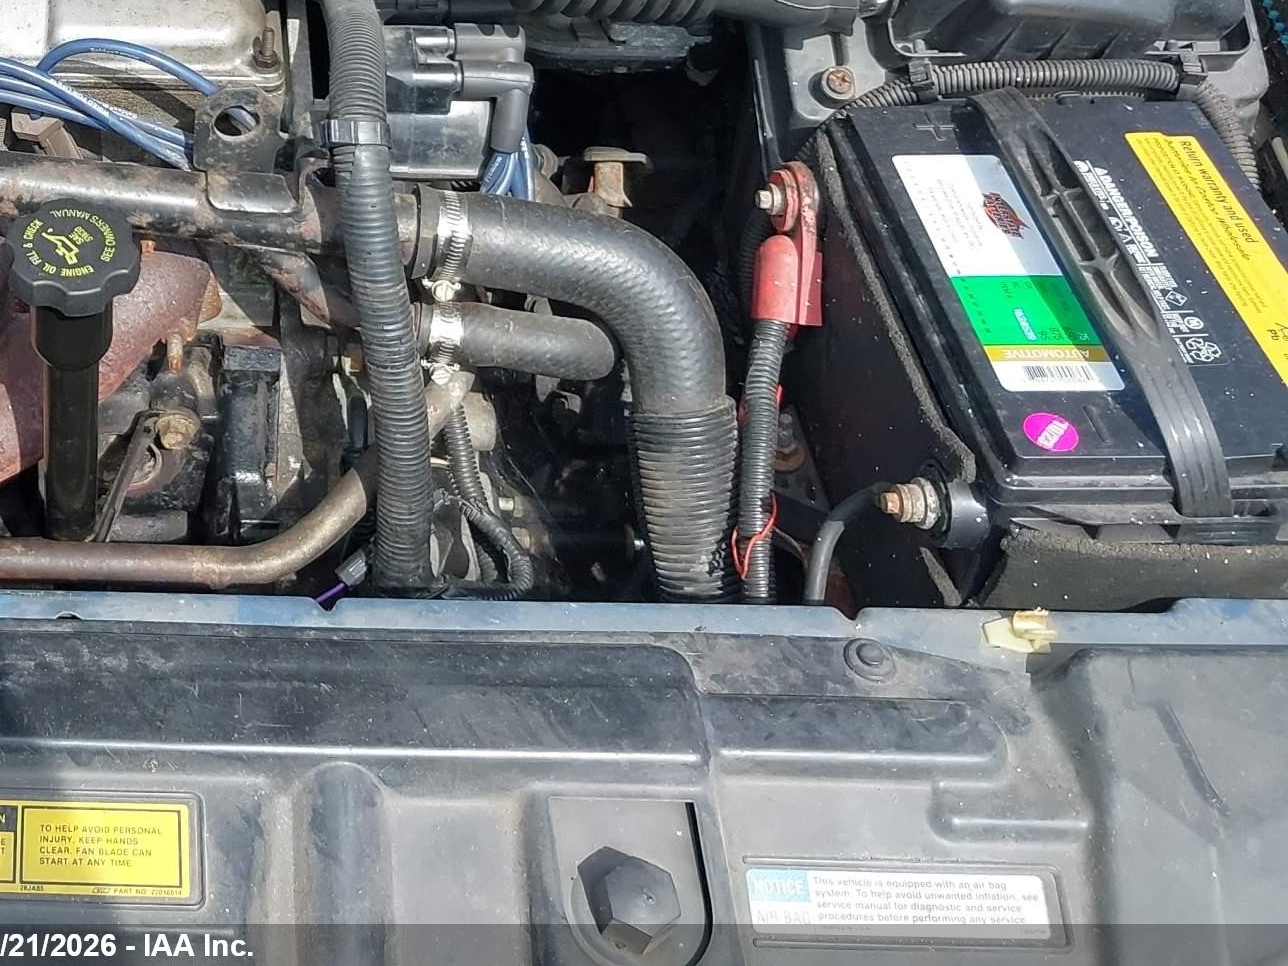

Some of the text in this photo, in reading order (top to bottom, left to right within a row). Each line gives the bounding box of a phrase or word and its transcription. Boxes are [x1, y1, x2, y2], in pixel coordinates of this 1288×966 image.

[1179, 140, 1260, 244] Return warranty and used
[49, 209, 91, 221] MANUAL
[1100, 171, 1160, 258] DANGER/POISON
[23, 218, 44, 241] CHECK
[26, 249, 43, 266] FILL
[100, 246, 116, 263] SEE
[42, 262, 58, 275] OIL
[59, 264, 95, 277] ENGINE
[1267, 328, 1281, 342] Pb
[1002, 348, 1090, 359] AUTOMOTIVE
[39, 824, 163, 836] TO HELP AVOID PERSONAL
[78, 835, 103, 845] KEEP
[106, 836, 139, 846] HANDS
[75, 846, 94, 856] FAN
[98, 847, 129, 857] BLADE
[131, 848, 152, 857] CAN
[39, 856, 68, 866] START
[71, 857, 84, 866] AT
[86, 857, 107, 867] ANY
[752, 877, 804, 895] NOTICE
[813, 876, 1007, 892] This vehicle is equipped with an air bag
[113, 888, 133, 896] PART
[856, 888, 1039, 902] To help avoid unwanted see
[816, 901, 1022, 914] service manual for diagnostic and service
[756, 910, 812, 924] AIR BAG
[818, 911, 987, 926] procedures before performing any
